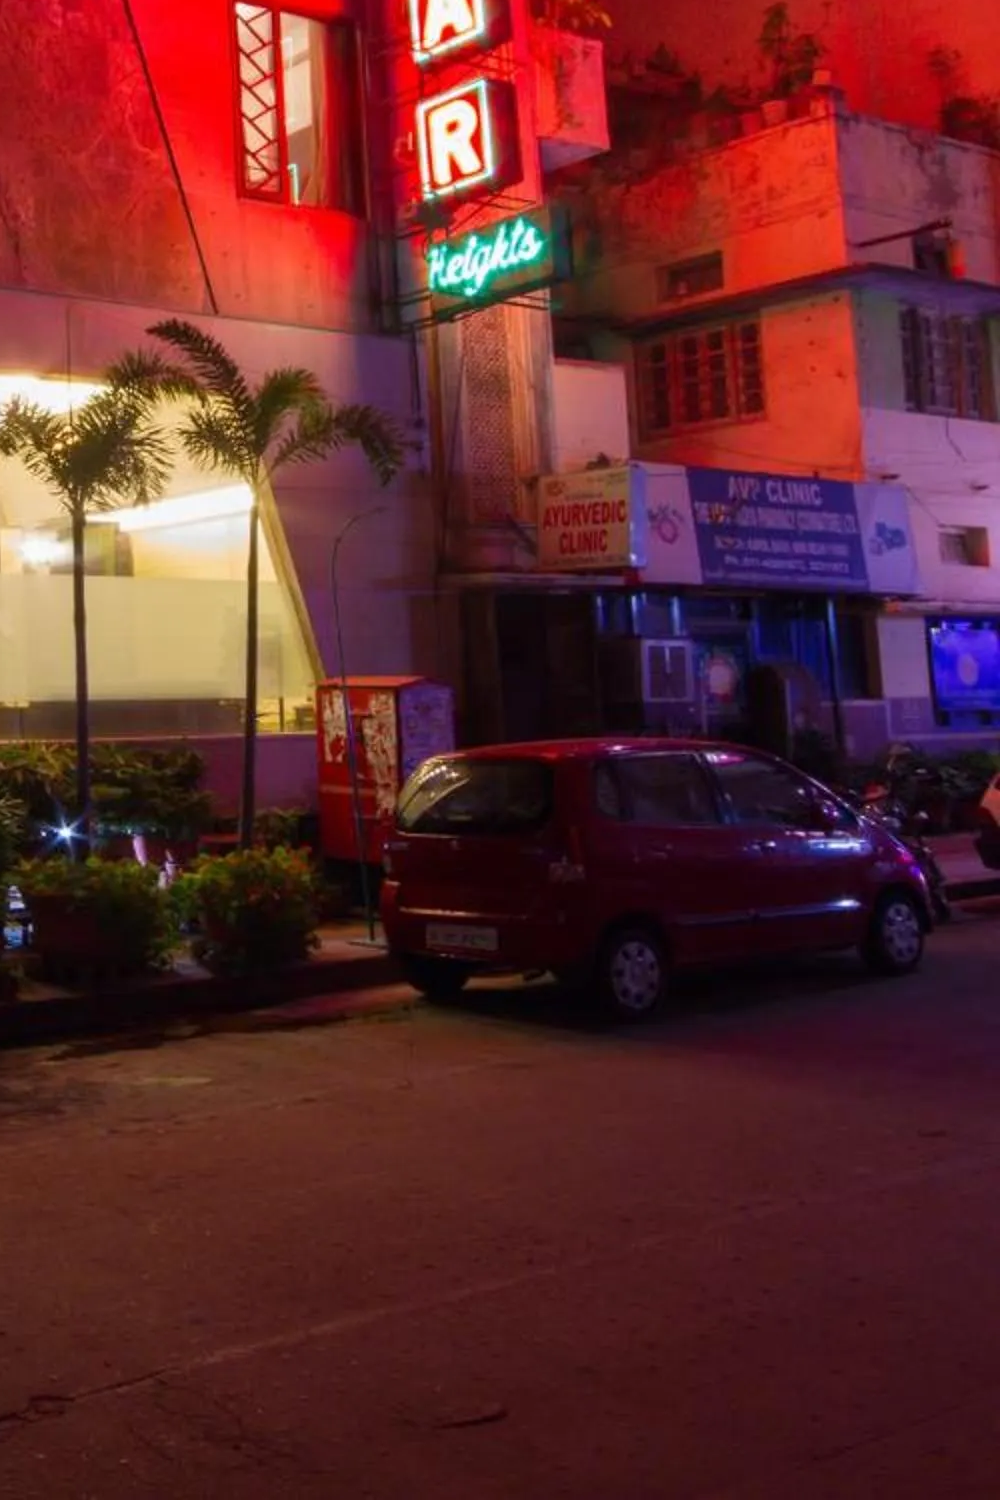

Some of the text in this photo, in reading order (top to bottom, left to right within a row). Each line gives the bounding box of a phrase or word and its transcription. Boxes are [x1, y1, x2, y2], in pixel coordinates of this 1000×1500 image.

[429, 217, 544, 297] Heights
[766, 480, 823, 506] CLINIC
[543, 499, 628, 531] AYURVEDIC
[560, 528, 608, 555] CLINIC
